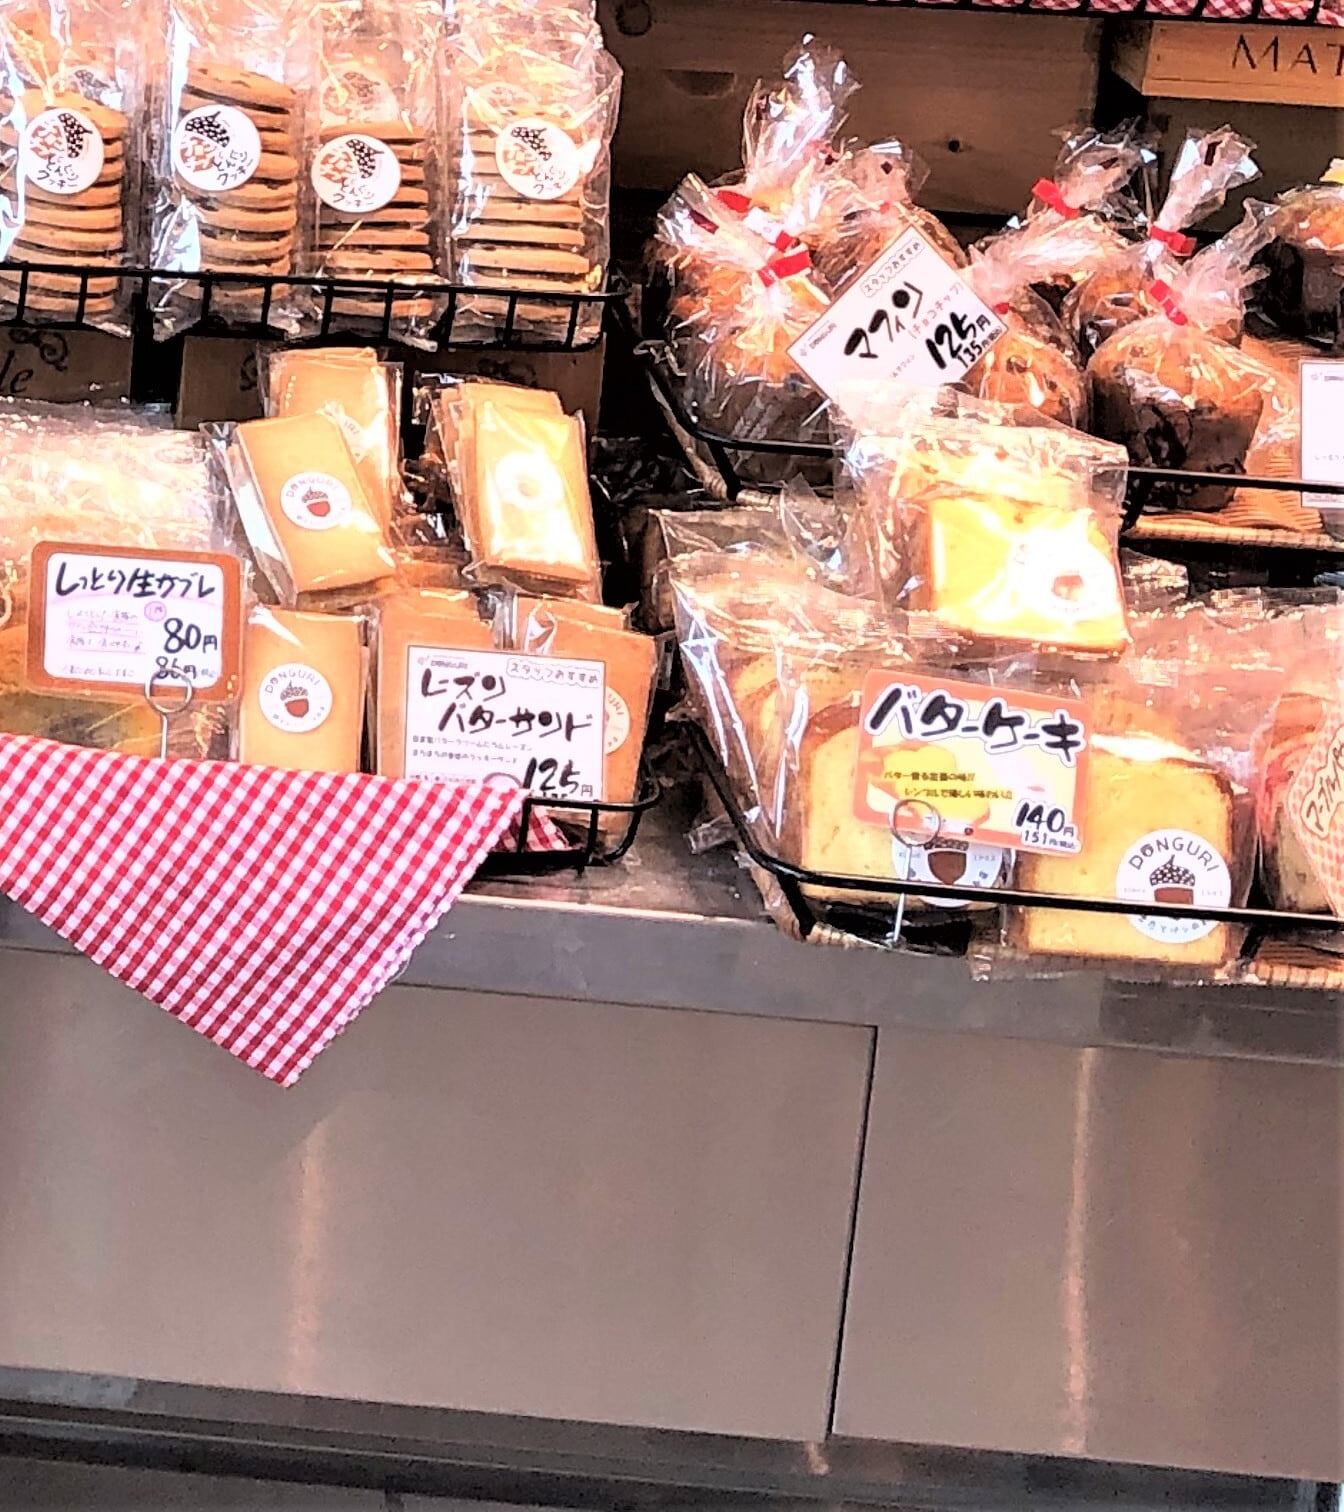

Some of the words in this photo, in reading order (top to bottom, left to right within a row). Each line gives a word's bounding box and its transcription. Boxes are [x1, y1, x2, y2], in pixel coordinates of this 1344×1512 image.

[844, 281, 923, 359] マフィン
[55, 562, 215, 598] しっとり生サブレ
[163, 618, 218, 654] 80円
[438, 702, 593, 742] バターサンド
[870, 688, 1081, 762] バターケーキ
[1015, 802, 1075, 837] 140円
